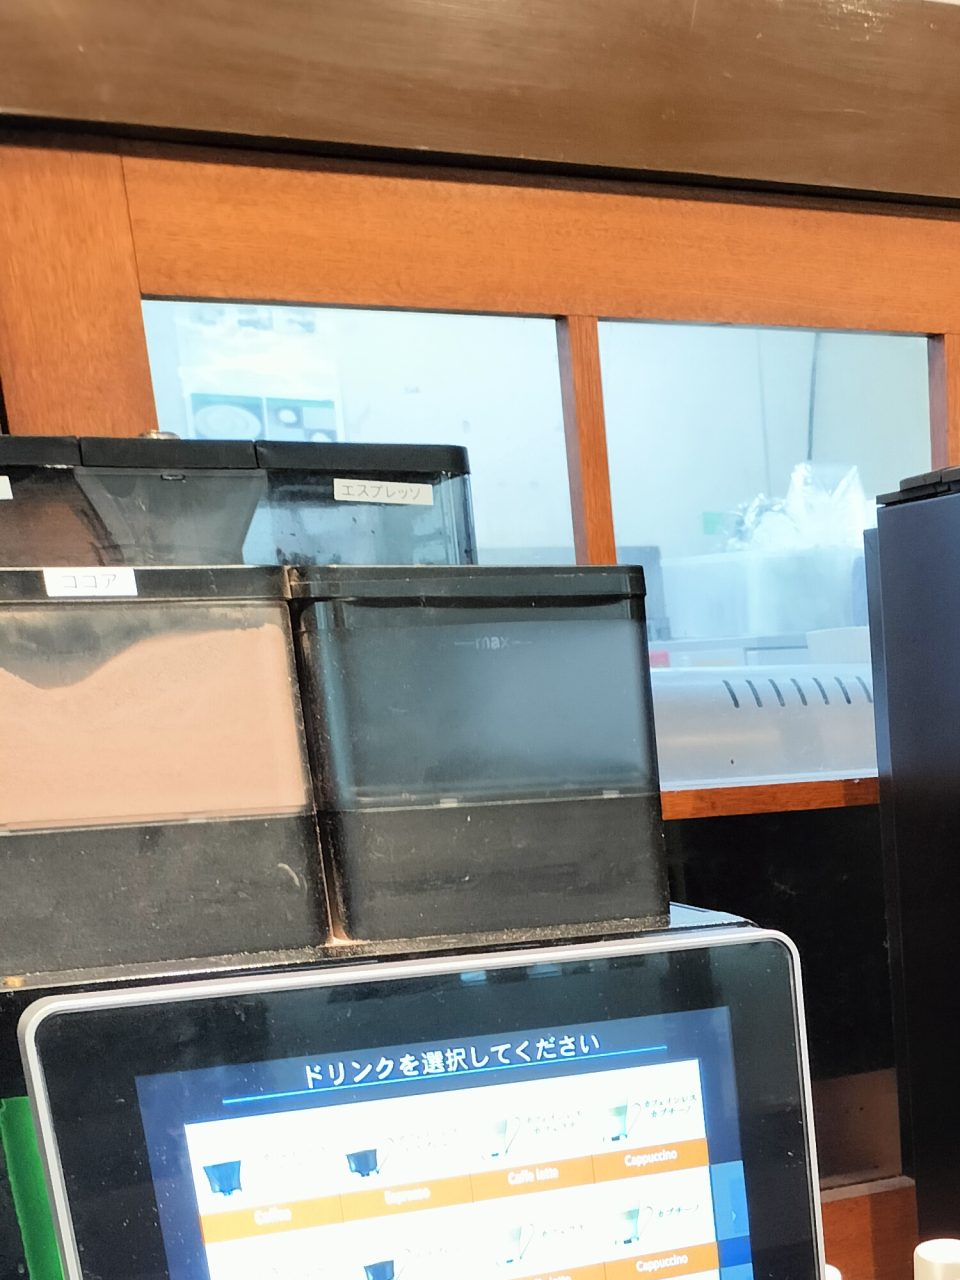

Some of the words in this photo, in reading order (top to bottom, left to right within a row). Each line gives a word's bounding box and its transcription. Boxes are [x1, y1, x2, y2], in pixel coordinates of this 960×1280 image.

[341, 484, 421, 500] エスプレッソ
[62, 574, 117, 589] ココア
[475, 636, 510, 650] max
[304, 1034, 600, 1089] ドリンクを選択してください
[624, 1148, 678, 1167] Cappuccino
[636, 1253, 688, 1273] Cappuccino
